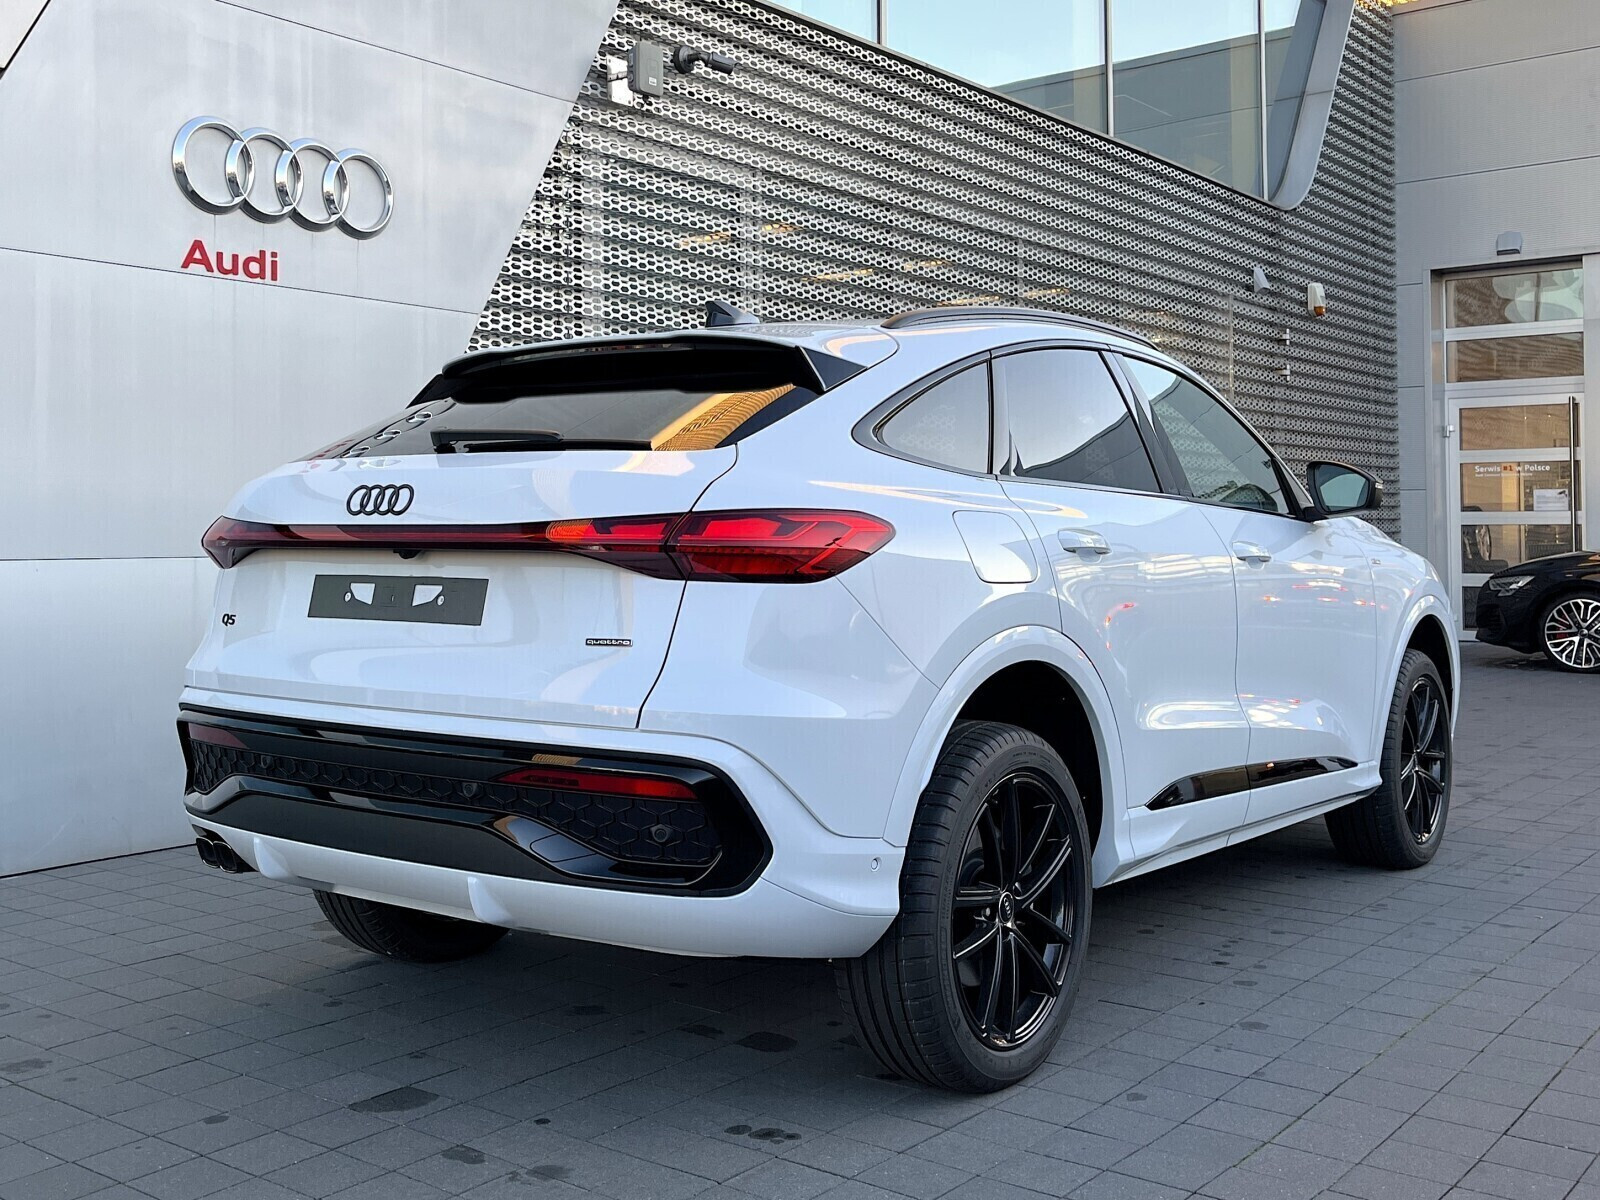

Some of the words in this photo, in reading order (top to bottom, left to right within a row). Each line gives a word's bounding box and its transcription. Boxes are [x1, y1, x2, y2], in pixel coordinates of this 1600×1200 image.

[181, 239, 278, 281] Audi
[1474, 465, 1501, 473] Serwis
[1524, 464, 1551, 472] Polsce
[221, 613, 237, 627] Q5
